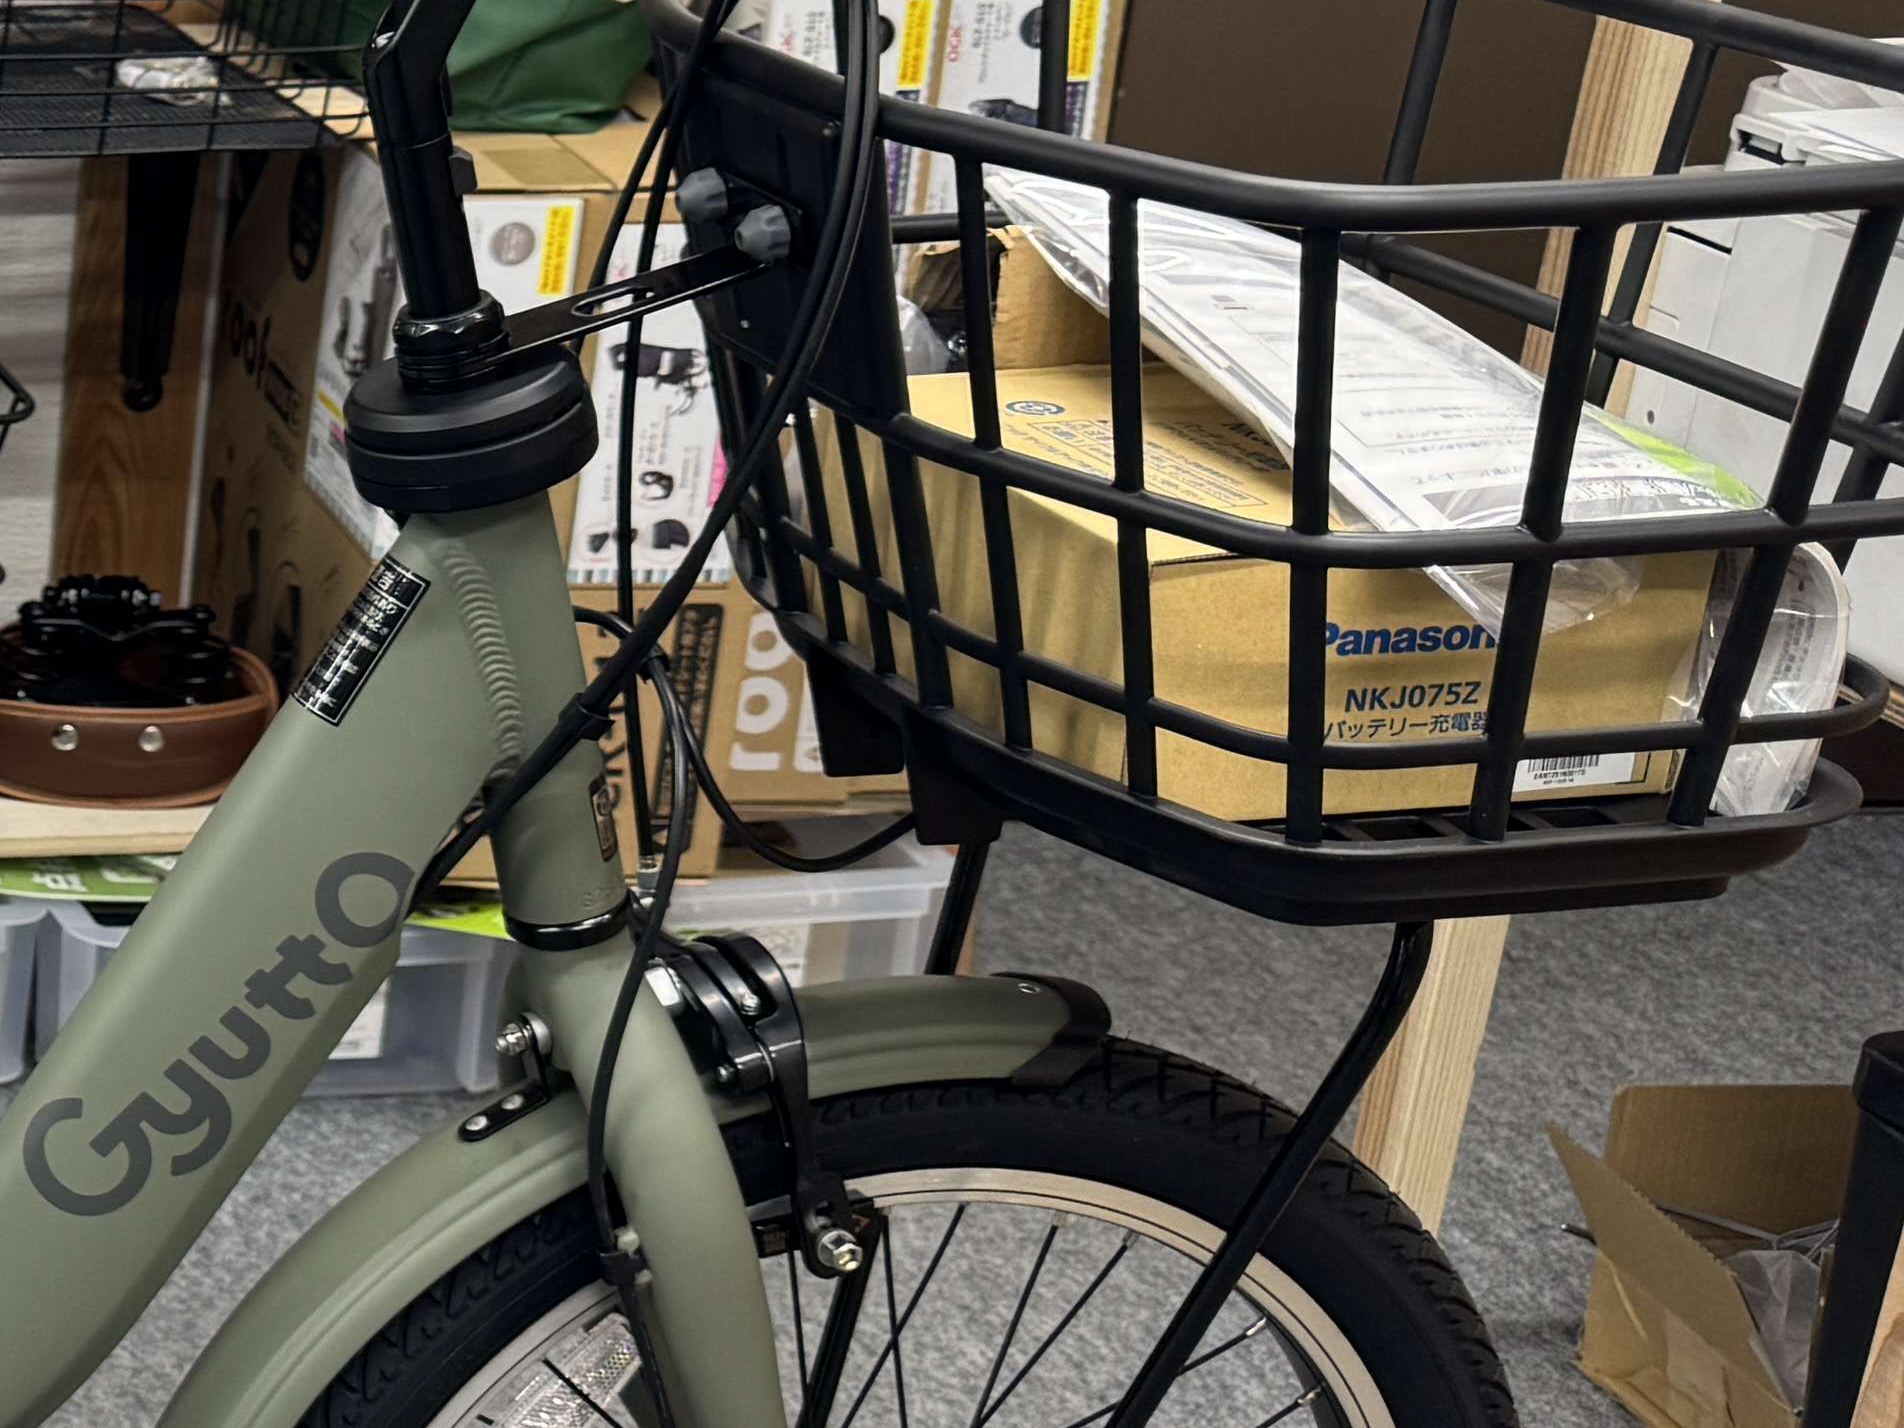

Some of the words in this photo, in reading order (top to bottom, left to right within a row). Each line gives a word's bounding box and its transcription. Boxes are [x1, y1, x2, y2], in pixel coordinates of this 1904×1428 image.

[1325, 622, 1497, 657] Panason
[1344, 680, 1482, 713] NKJ075Z
[1324, 711, 1489, 739] バッテリー充電器
